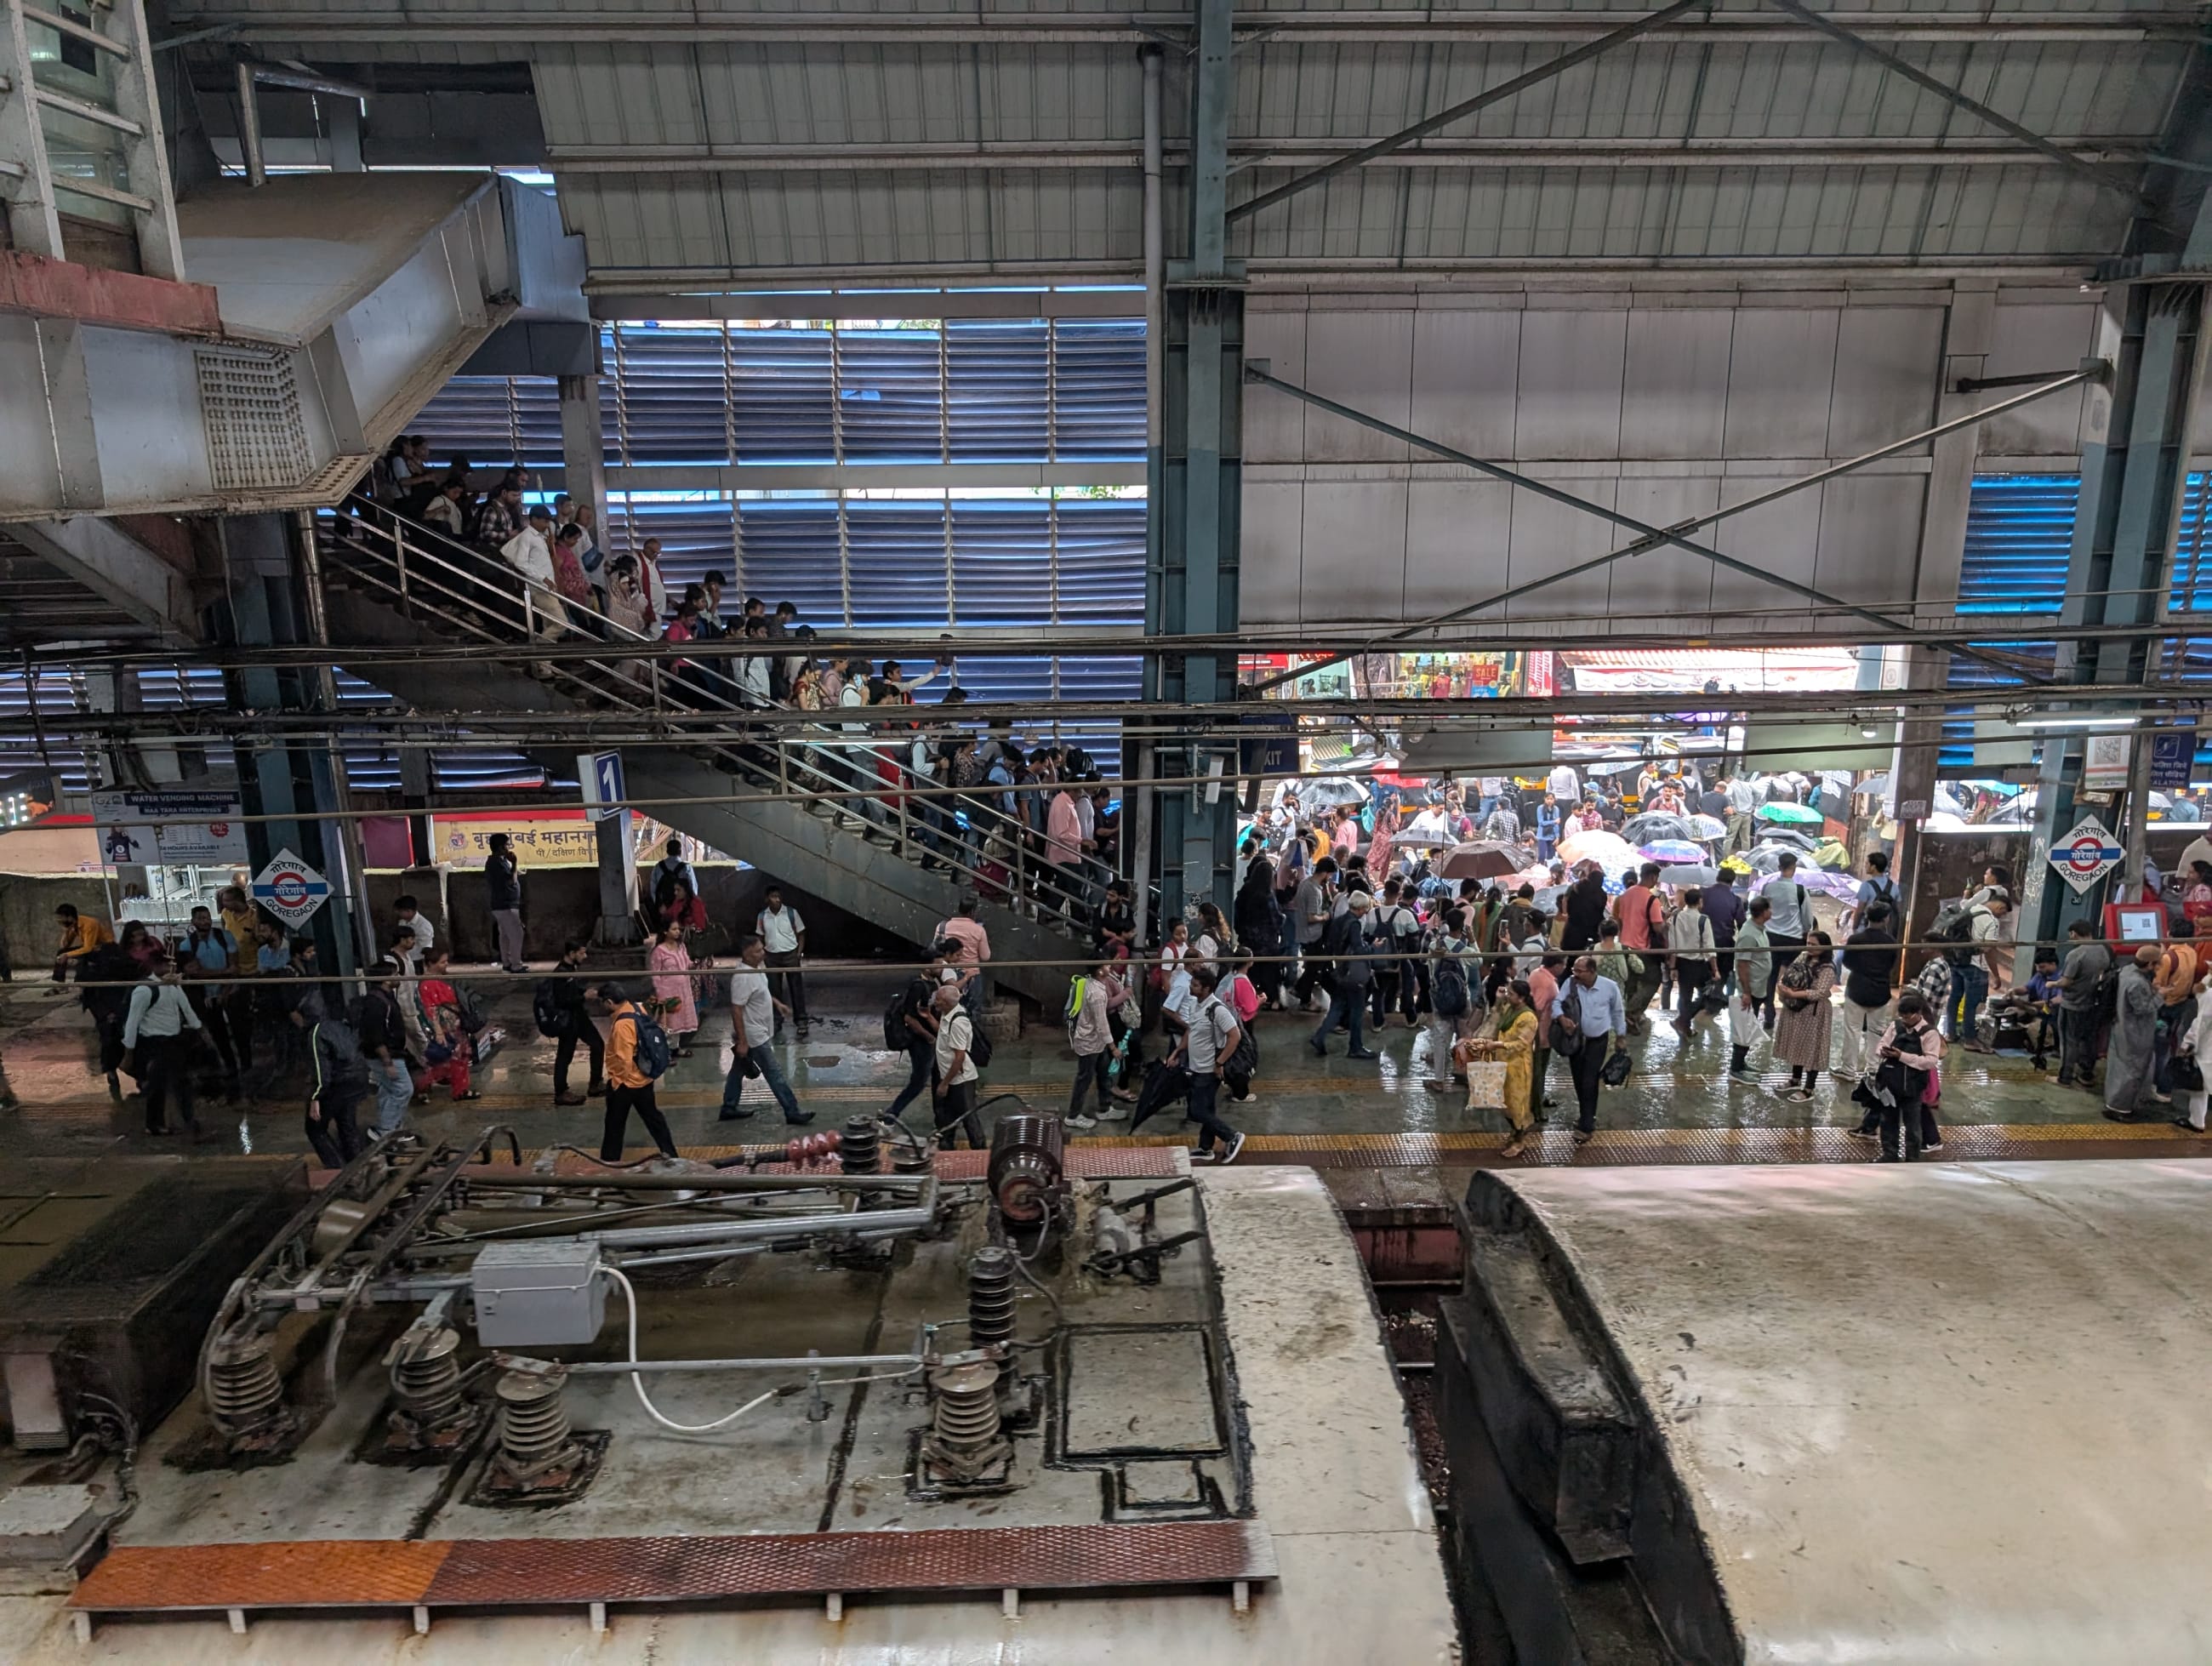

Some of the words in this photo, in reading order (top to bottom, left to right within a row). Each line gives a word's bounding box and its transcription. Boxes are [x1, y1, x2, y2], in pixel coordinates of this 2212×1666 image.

[1475, 668, 1497, 677] SALE
[602, 761, 618, 802] 1
[2059, 863, 2108, 881] GOREGAON
[265, 899, 318, 917] GOREGAON
